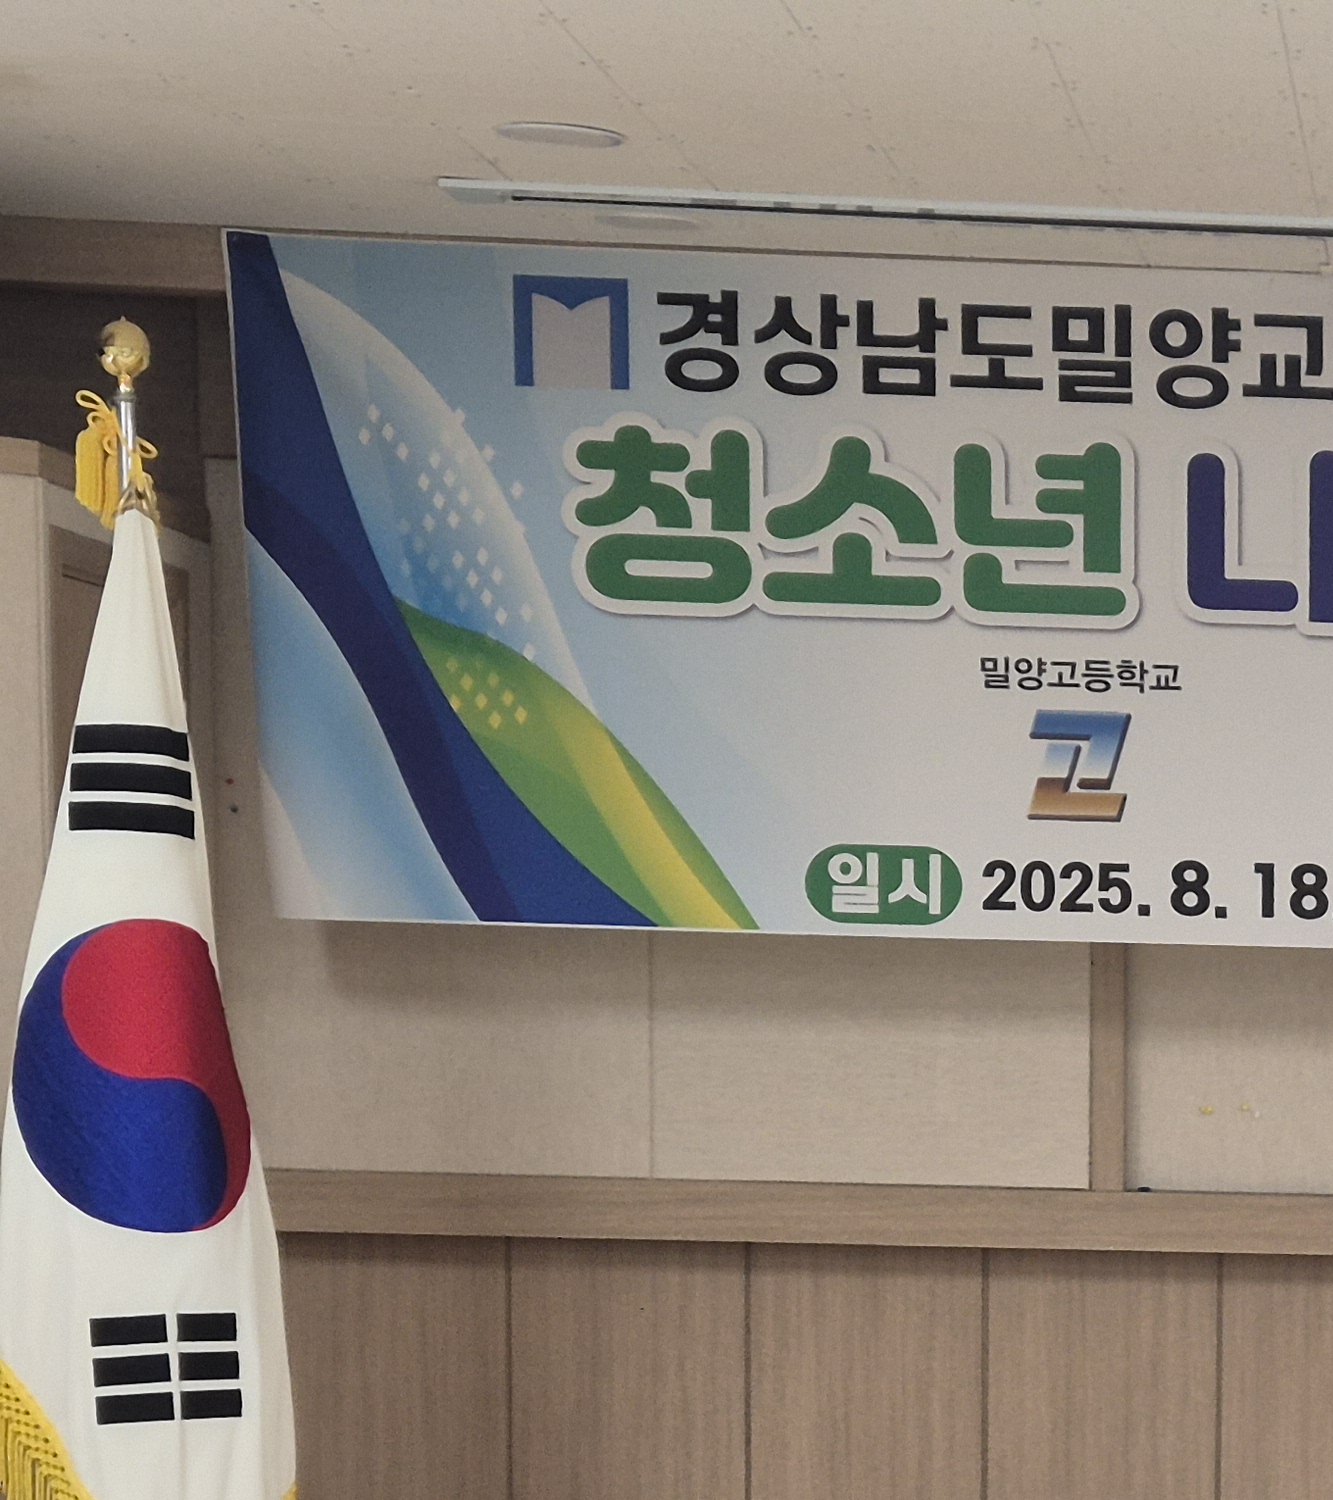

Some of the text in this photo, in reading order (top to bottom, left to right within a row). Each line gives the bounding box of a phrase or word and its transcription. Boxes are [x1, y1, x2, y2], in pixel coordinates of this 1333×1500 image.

[575, 424, 1126, 614] 청소년
[980, 656, 1182, 694] 밀양고등학교
[828, 852, 942, 914] 일시
[982, 859, 1150, 917] 2025.
[1170, 859, 1228, 919] 8.
